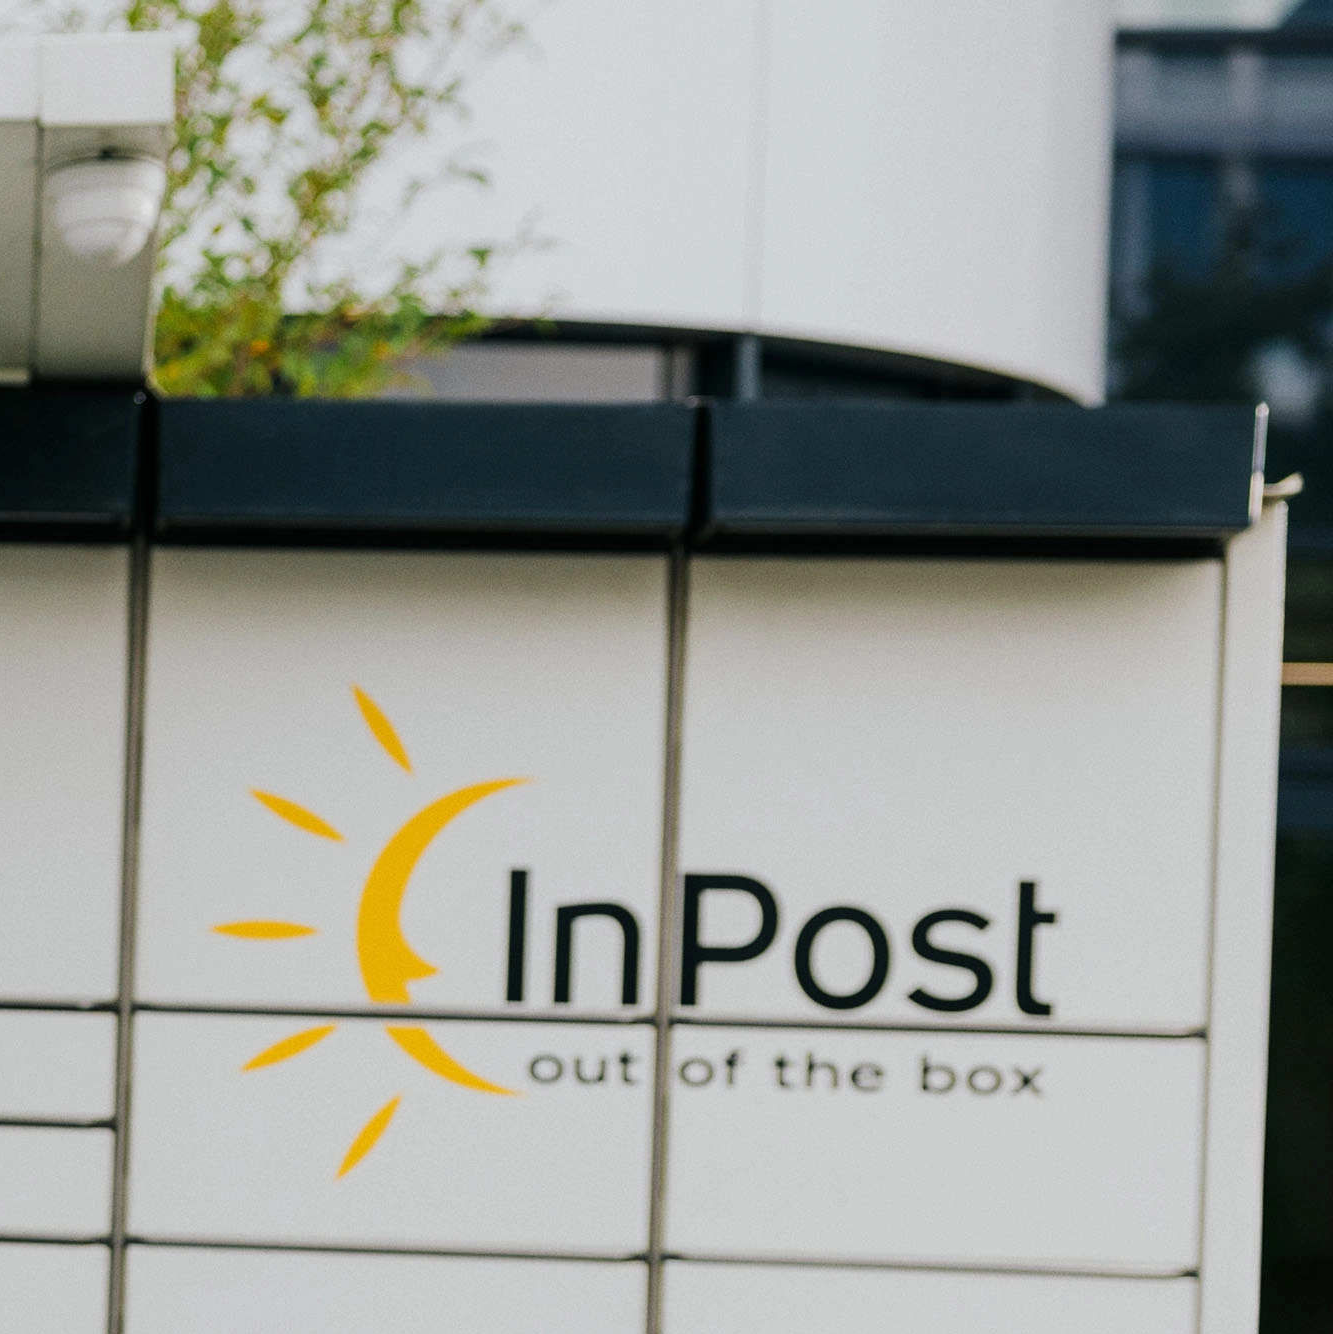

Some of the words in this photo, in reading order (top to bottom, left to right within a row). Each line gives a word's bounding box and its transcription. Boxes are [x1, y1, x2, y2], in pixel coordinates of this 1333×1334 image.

[506, 869, 1056, 1016] InPost
[529, 1052, 638, 1087] out
[678, 1047, 744, 1088] of
[774, 1051, 886, 1092] the
[921, 1054, 1045, 1096] box
